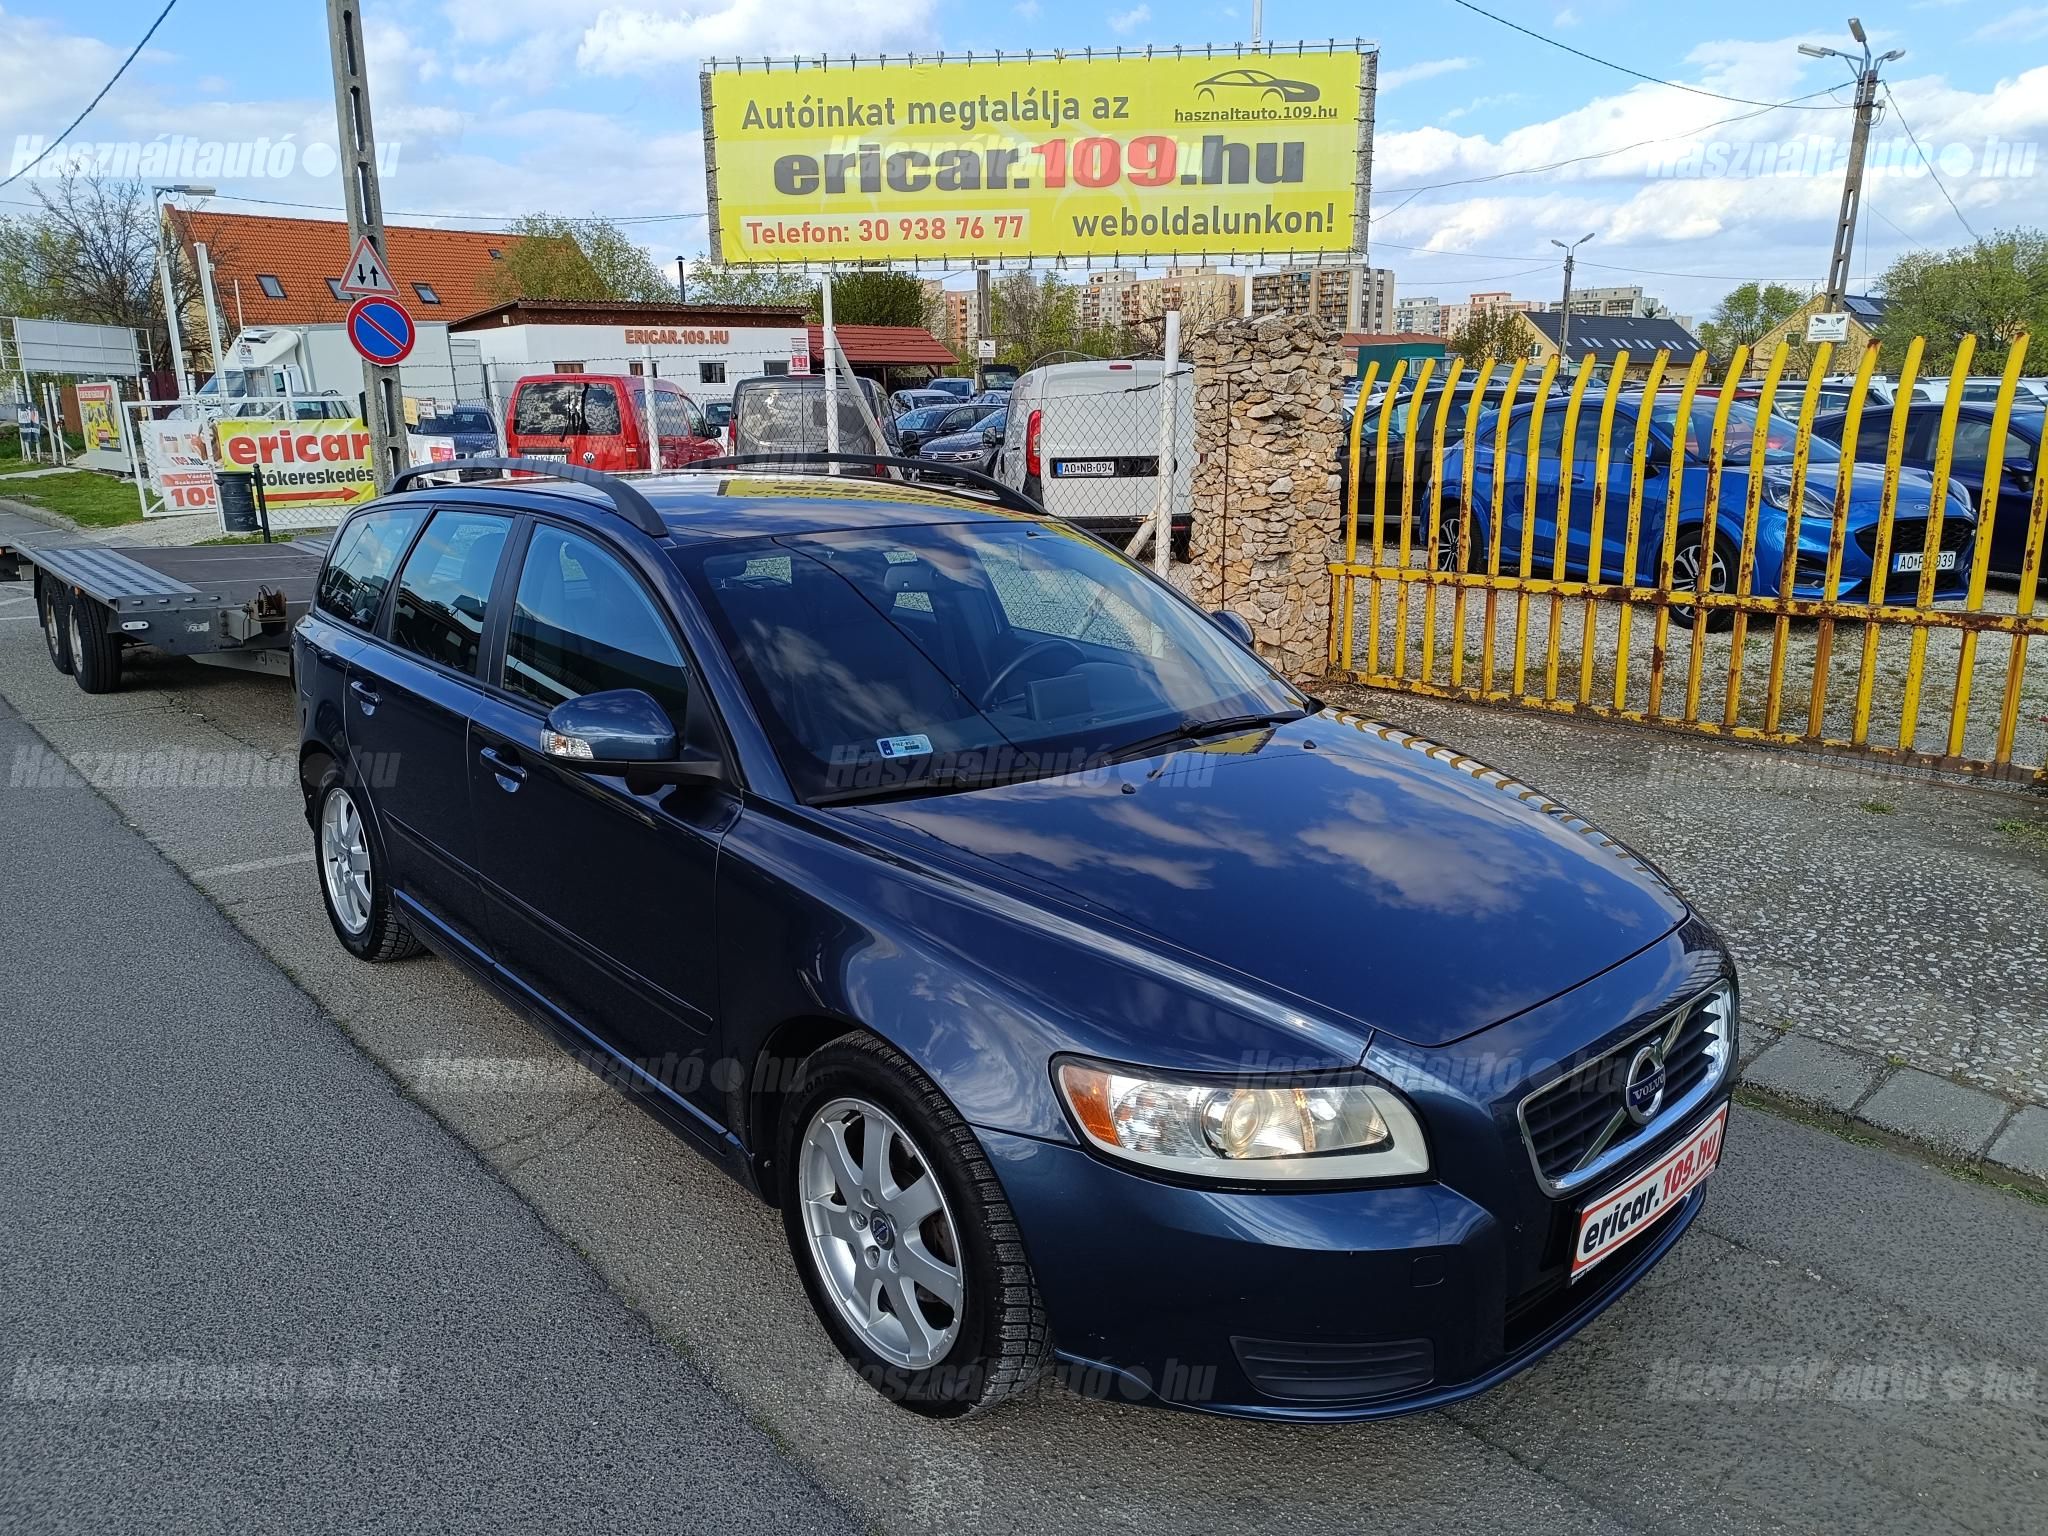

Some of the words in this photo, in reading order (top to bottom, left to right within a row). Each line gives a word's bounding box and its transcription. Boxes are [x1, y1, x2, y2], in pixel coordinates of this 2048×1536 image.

[742, 94, 895, 130] Autóinkat
[907, 87, 1080, 131] megtalálja
[1092, 96, 1129, 120] az
[1174, 105, 1338, 122] hasznaltauto.109.hu
[773, 135, 1305, 195] ericar.109.hu
[746, 222, 849, 244] Telefon:
[858, 219, 889, 242] 30
[899, 217, 946, 241] 938
[955, 216, 985, 239] 76
[993, 215, 1024, 238] 77
[1072, 203, 1334, 238] weboldalunkon!
[624, 329, 729, 345] ERICAR.109.HU
[228, 430, 371, 465] ericar
[1582, 1131, 1718, 1255] ericar.109.hu
